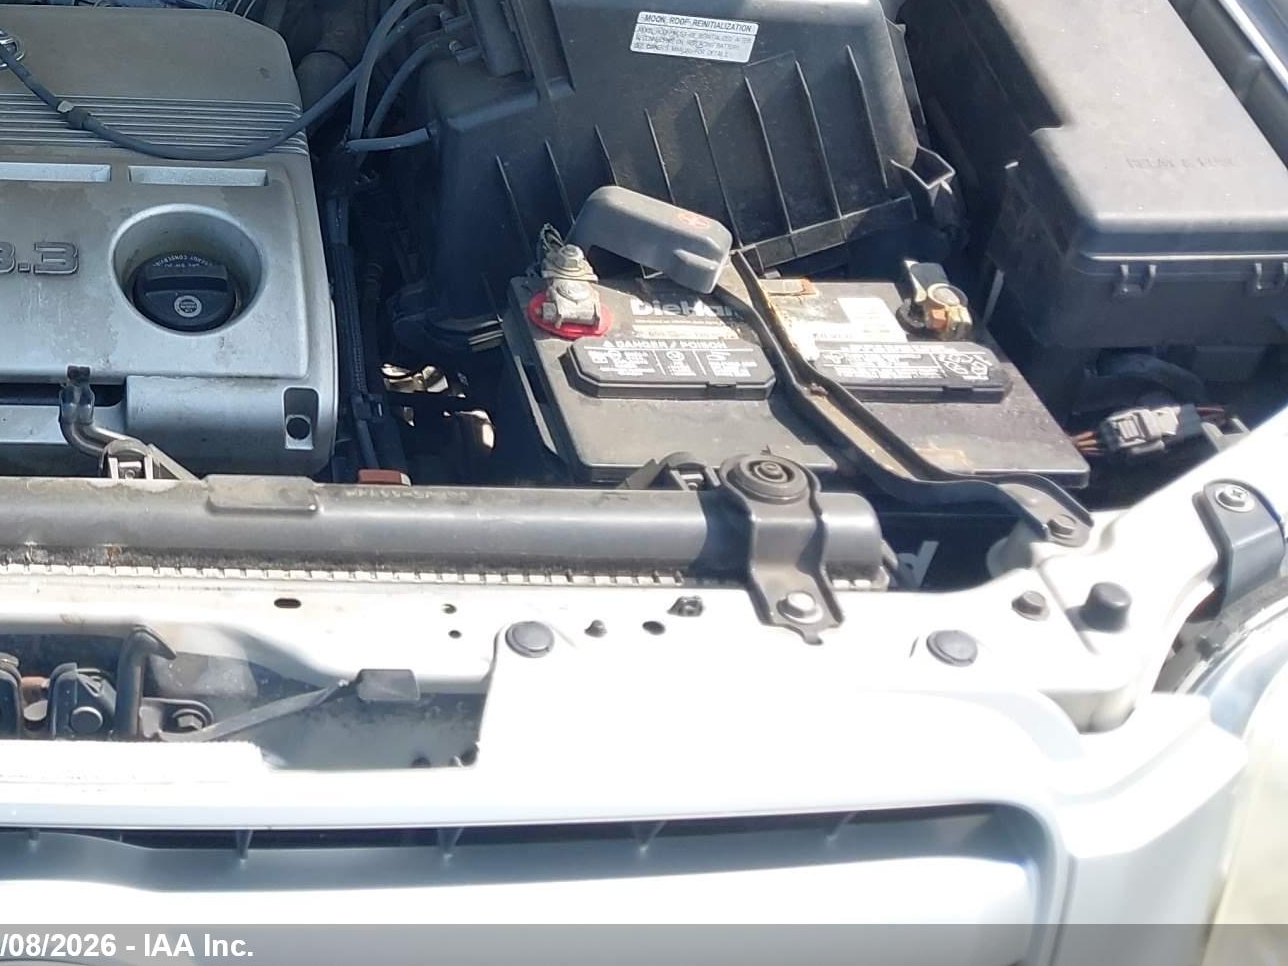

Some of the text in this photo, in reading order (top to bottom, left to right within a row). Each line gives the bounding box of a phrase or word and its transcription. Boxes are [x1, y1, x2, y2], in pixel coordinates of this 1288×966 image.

[644, 14, 753, 33] MOON ROOF REINITIALIZATION
[616, 340, 669, 349] DANGER
[679, 340, 728, 349] POISON
